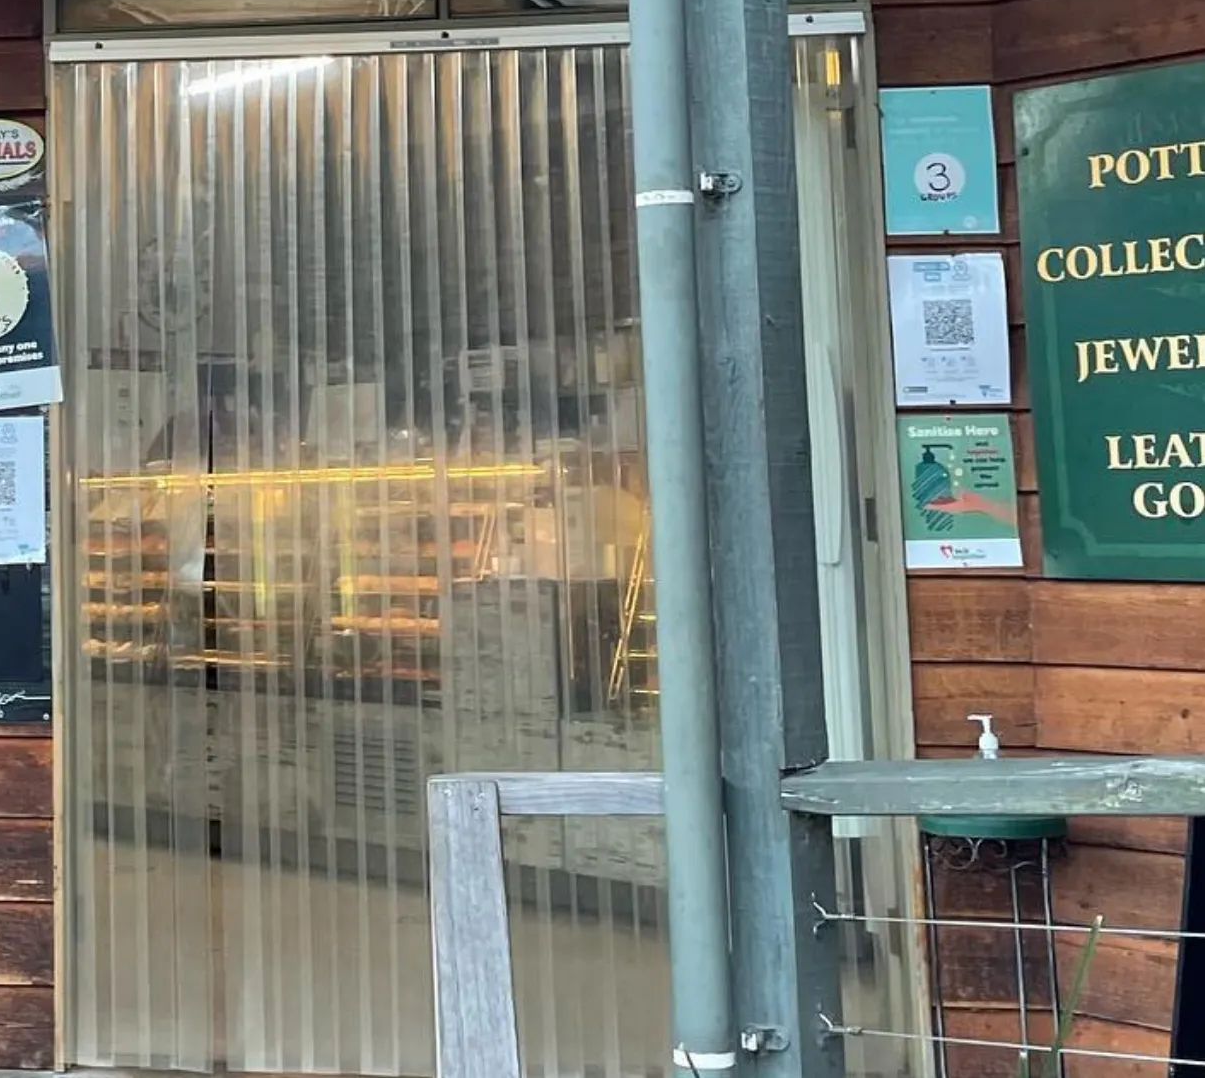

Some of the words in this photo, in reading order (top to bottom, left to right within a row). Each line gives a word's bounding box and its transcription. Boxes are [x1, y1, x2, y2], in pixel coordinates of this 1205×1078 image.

[926, 162, 951, 191] 3
[1088, 140, 1205, 189] POTT
[1037, 234, 1205, 282] COLLEC
[16, 341, 38, 351] one
[964, 425, 1000, 436] Here
[1132, 481, 1205, 519] GO
